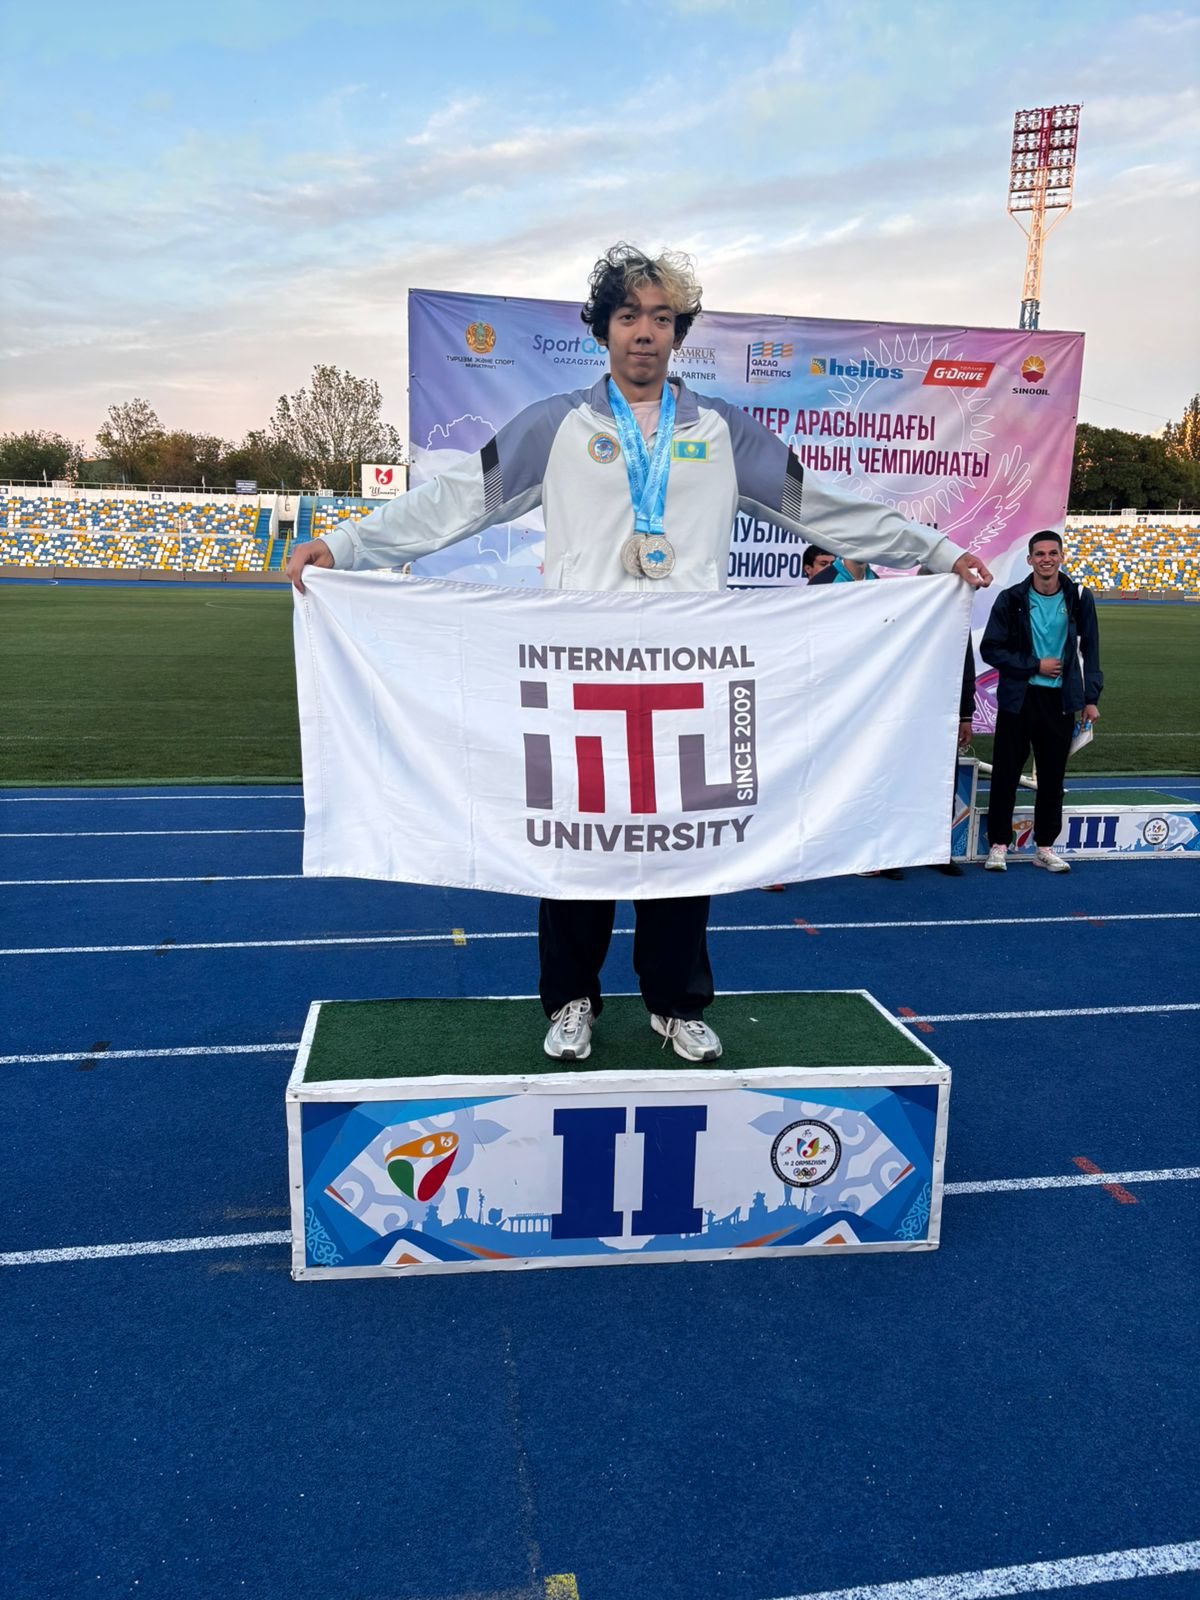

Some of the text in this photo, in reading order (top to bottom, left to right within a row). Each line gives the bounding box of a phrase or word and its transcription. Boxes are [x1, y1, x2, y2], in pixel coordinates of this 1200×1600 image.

[553, 357, 606, 367] QAZAQSTAN
[674, 347, 716, 360] SAMRUK
[751, 359, 778, 367] QAZAQ
[681, 371, 716, 380] PARTNER
[751, 368, 792, 378] ATHLETICS
[829, 358, 904, 380] helios
[1012, 387, 1050, 396] SINOOIL
[742, 406, 936, 442] ДЕР АРАСЫНДАҒЫ
[858, 447, 990, 478] ЧЕМПИОНАТЫ
[518, 643, 756, 671] INTERNATIONAL
[733, 686, 754, 801] SINCE 2009
[526, 814, 755, 853] UNIVERSITY
[1066, 816, 1120, 849] III
[551, 1104, 708, 1240] II
